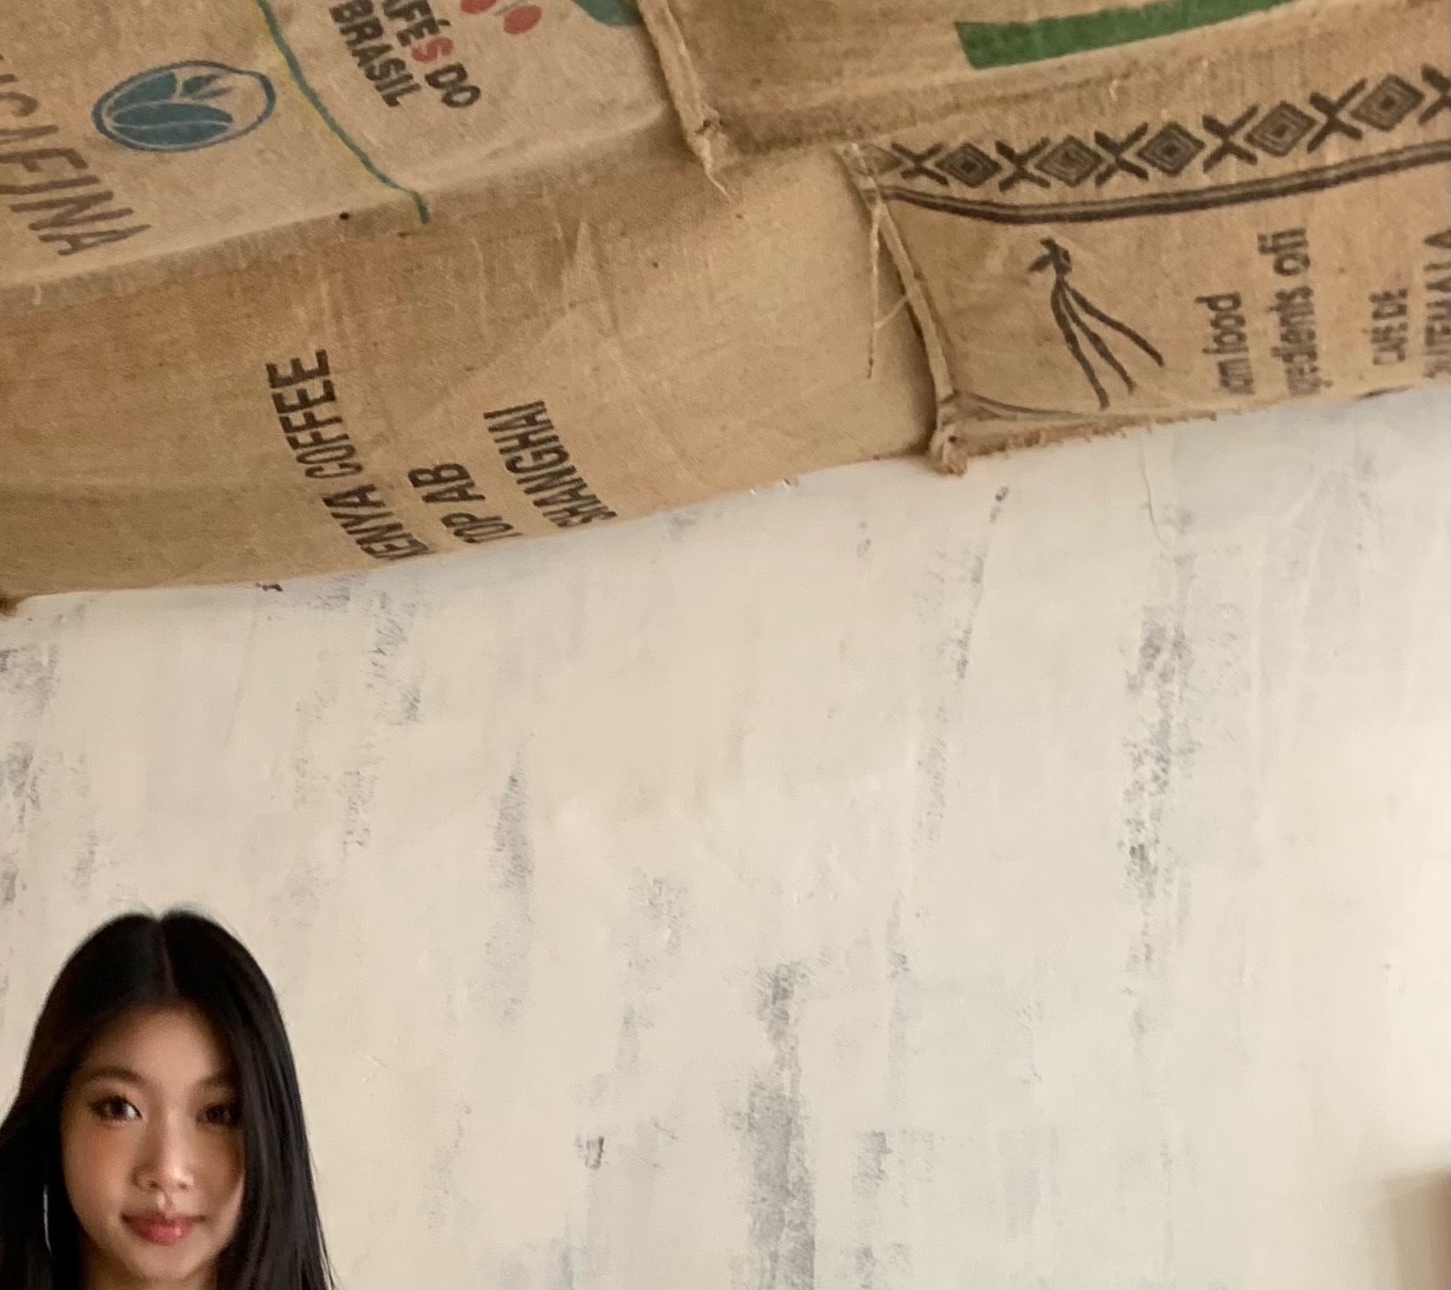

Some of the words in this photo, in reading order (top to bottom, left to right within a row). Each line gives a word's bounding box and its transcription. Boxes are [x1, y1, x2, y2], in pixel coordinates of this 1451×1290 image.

[329, 0, 421, 107] BRASIL
[424, 62, 481, 108] DO
[1194, 290, 1248, 354] food
[266, 349, 364, 480] COFFEE
[408, 462, 485, 508] AB
[483, 400, 617, 528] SHANGHAI
